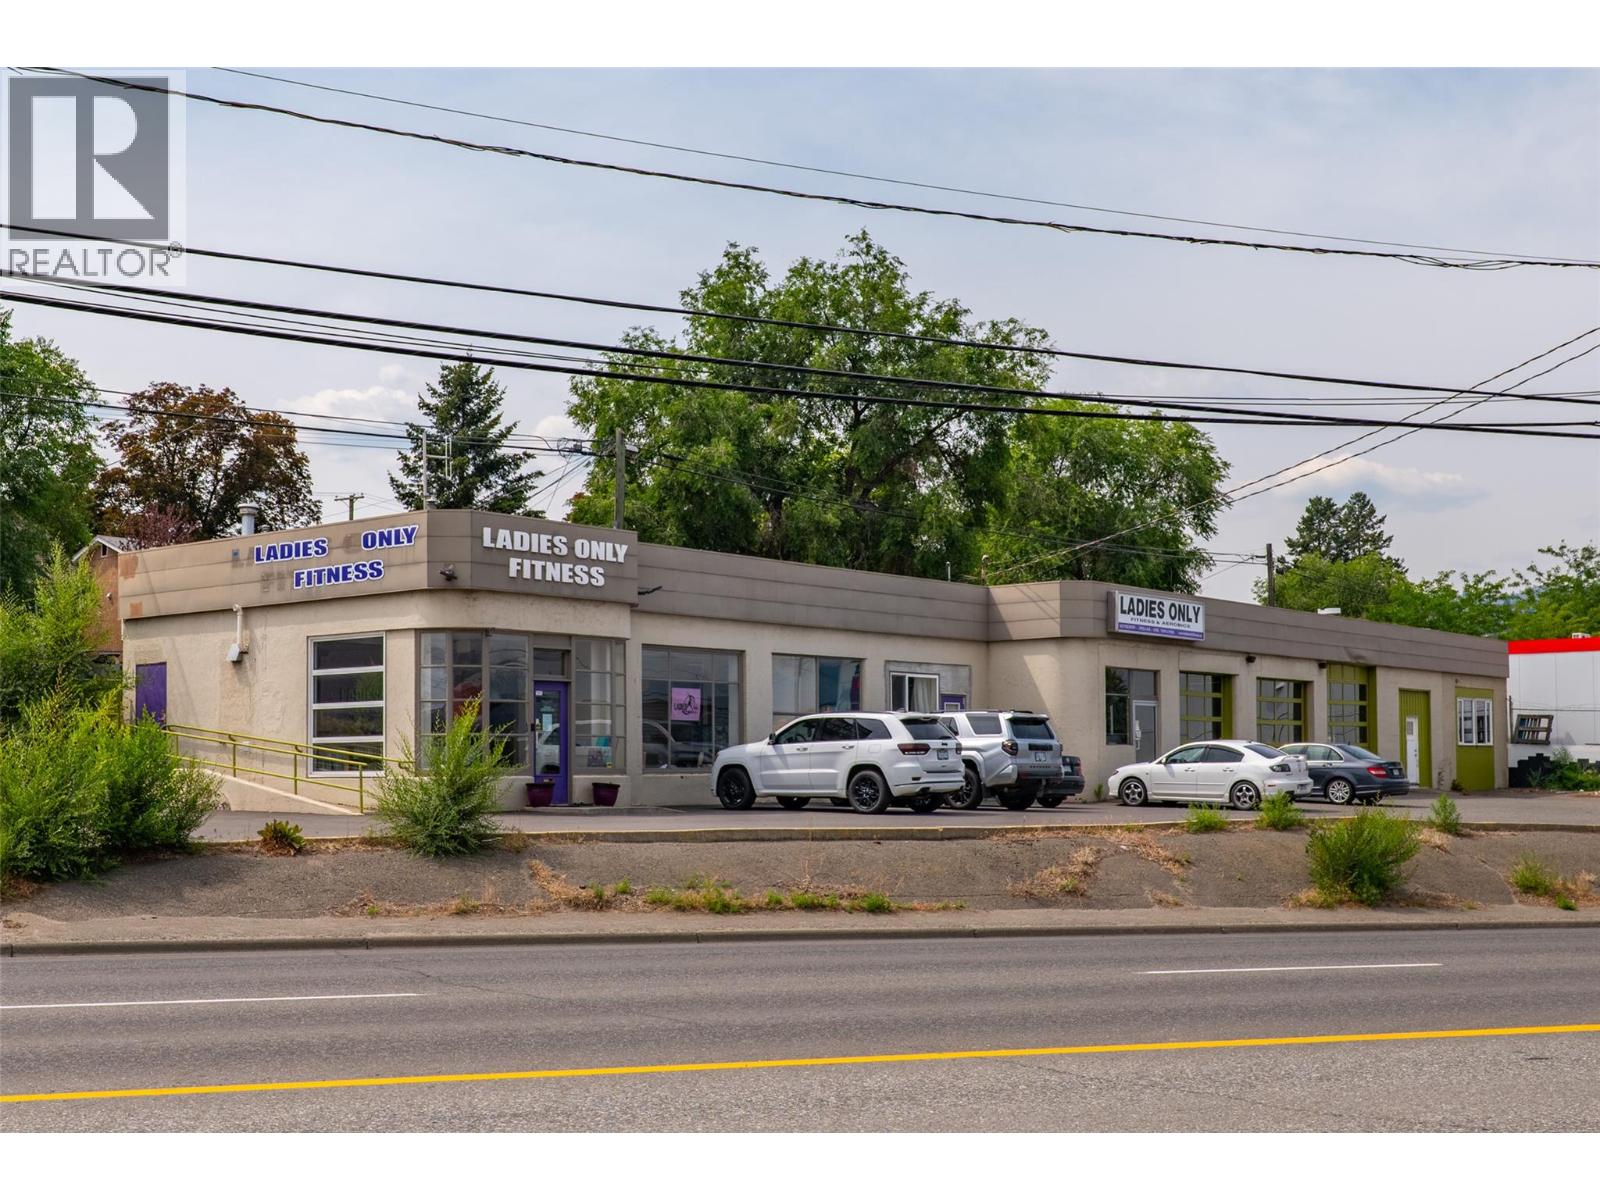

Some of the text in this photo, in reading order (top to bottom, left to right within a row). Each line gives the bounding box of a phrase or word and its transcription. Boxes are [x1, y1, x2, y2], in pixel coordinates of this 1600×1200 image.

[255, 524, 420, 564] LADIES ONLY
[482, 526, 628, 563] LADIES ONLY
[293, 560, 385, 590] FITNESS
[508, 557, 606, 587] FITNESS
[1120, 596, 1200, 623] LADIES ONLY
